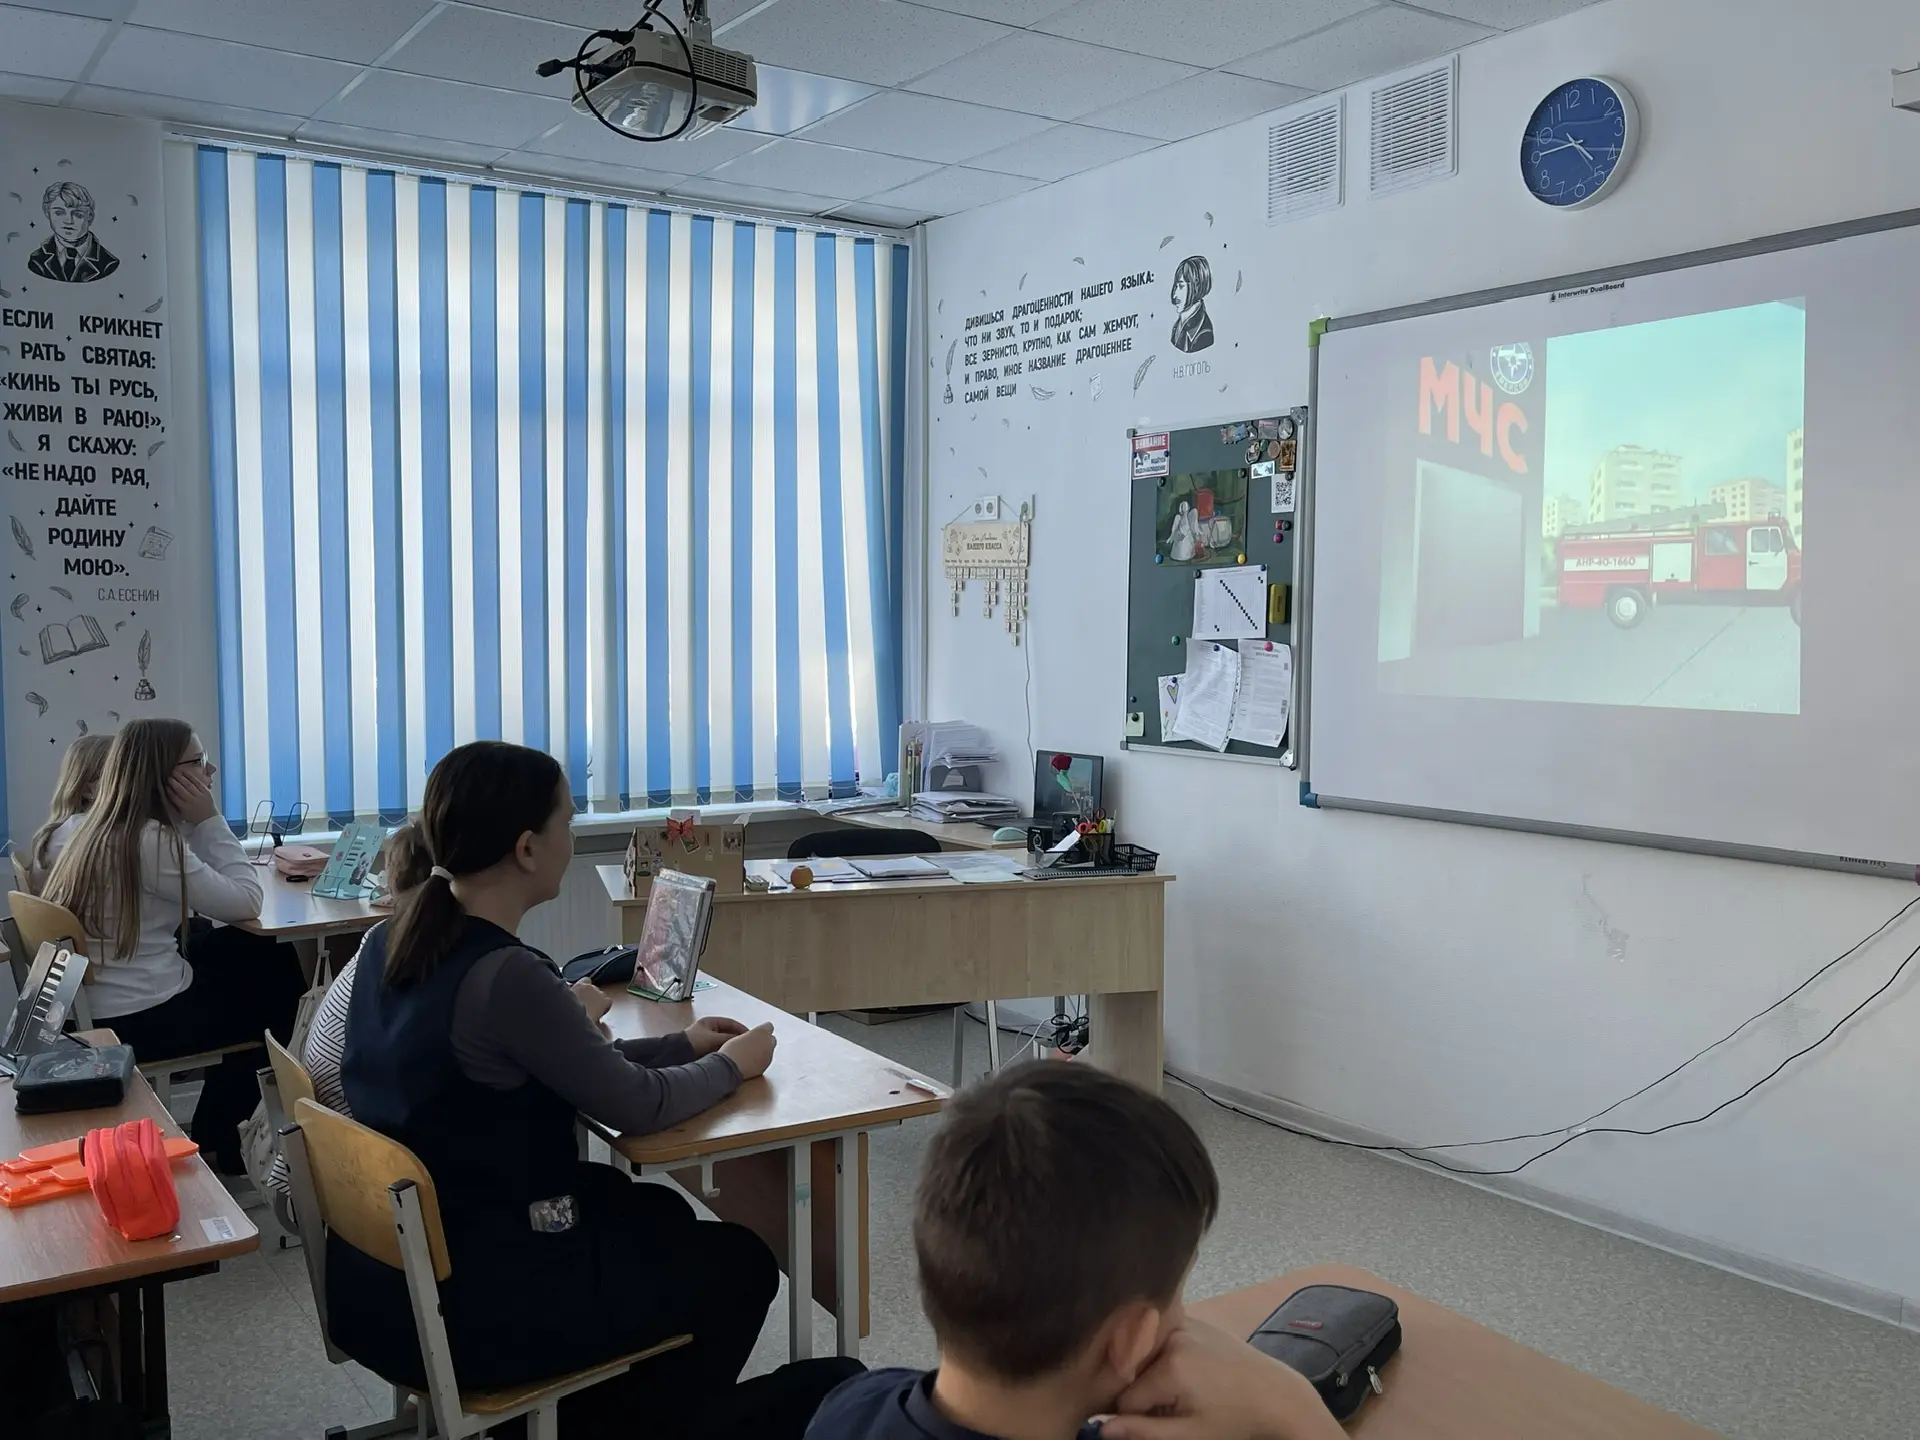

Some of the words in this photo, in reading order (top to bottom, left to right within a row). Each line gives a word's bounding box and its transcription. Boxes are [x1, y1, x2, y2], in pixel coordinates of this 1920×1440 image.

[1564, 89, 1581, 110] 12
[1603, 96, 1617, 117] 2
[1549, 103, 1562, 125] 11
[1535, 126, 1554, 147] 10
[1613, 116, 1625, 137] 3
[1530, 150, 1542, 168] 9
[1606, 142, 1618, 161] 4
[1540, 169, 1551, 189] 8
[1593, 164, 1606, 186] 5
[1555, 180, 1566, 198] 7
[1574, 180, 1586, 198] 6
[964, 309, 1005, 332] ДИВИШЬСЯ
[1012, 290, 1074, 320] ДРАГОЦЕННОСТИ
[1080, 280, 1114, 301] НАШЕГО
[1120, 270, 1155, 291] ЯЗЫКА:
[2, 308, 54, 330] ЕСЛИ
[79, 315, 163, 339] КРИКНЕТ
[964, 334, 978, 348] ЧТО
[981, 331, 992, 344] НИ
[1020, 321, 1030, 335] ТО
[1033, 319, 1039, 332] И
[964, 352, 978, 367] ВСЕ
[981, 343, 1019, 362] ЗЕРНИСТО,
[1022, 335, 1053, 354] КРУПНО,
[1056, 330, 1072, 345] КАК
[1078, 324, 1097, 340] САМ
[1102, 313, 1139, 335] ЖЕМЧУГ,
[20, 341, 66, 362] РАТЬ
[82, 345, 156, 370] СВЯТАЯ:
[964, 373, 970, 385] И
[975, 367, 999, 383] ПРАВО,
[1003, 362, 1023, 378] ИНОЕ
[1028, 352, 1067, 373] НАЗВАНИЕ
[1075, 337, 1132, 364] ДРАГОЦЕННЕЕ
[0, 371, 61, 393] «КИНЬ
[71, 376, 100, 396] ТЫ
[109, 378, 158, 402] РУСЬ,
[964, 385, 989, 404] САМОЙ
[996, 383, 1017, 398] ВЕЩИ
[3, 402, 63, 424] ЖИВИ
[75, 406, 88, 425] В
[103, 408, 165, 433] РАЮ!»,
[1418, 356, 1528, 474] МЧС
[37, 433, 51, 452] Я
[68, 435, 137, 456] СКАЖУ:
[2, 462, 40, 481] «НЕ
[44, 464, 97, 486] НАДО
[111, 467, 150, 489] РАЯ,
[55, 493, 117, 518] ДАЙТЕ
[48, 527, 126, 549] РОДИНУ
[64, 558, 130, 577] МОЮ».
